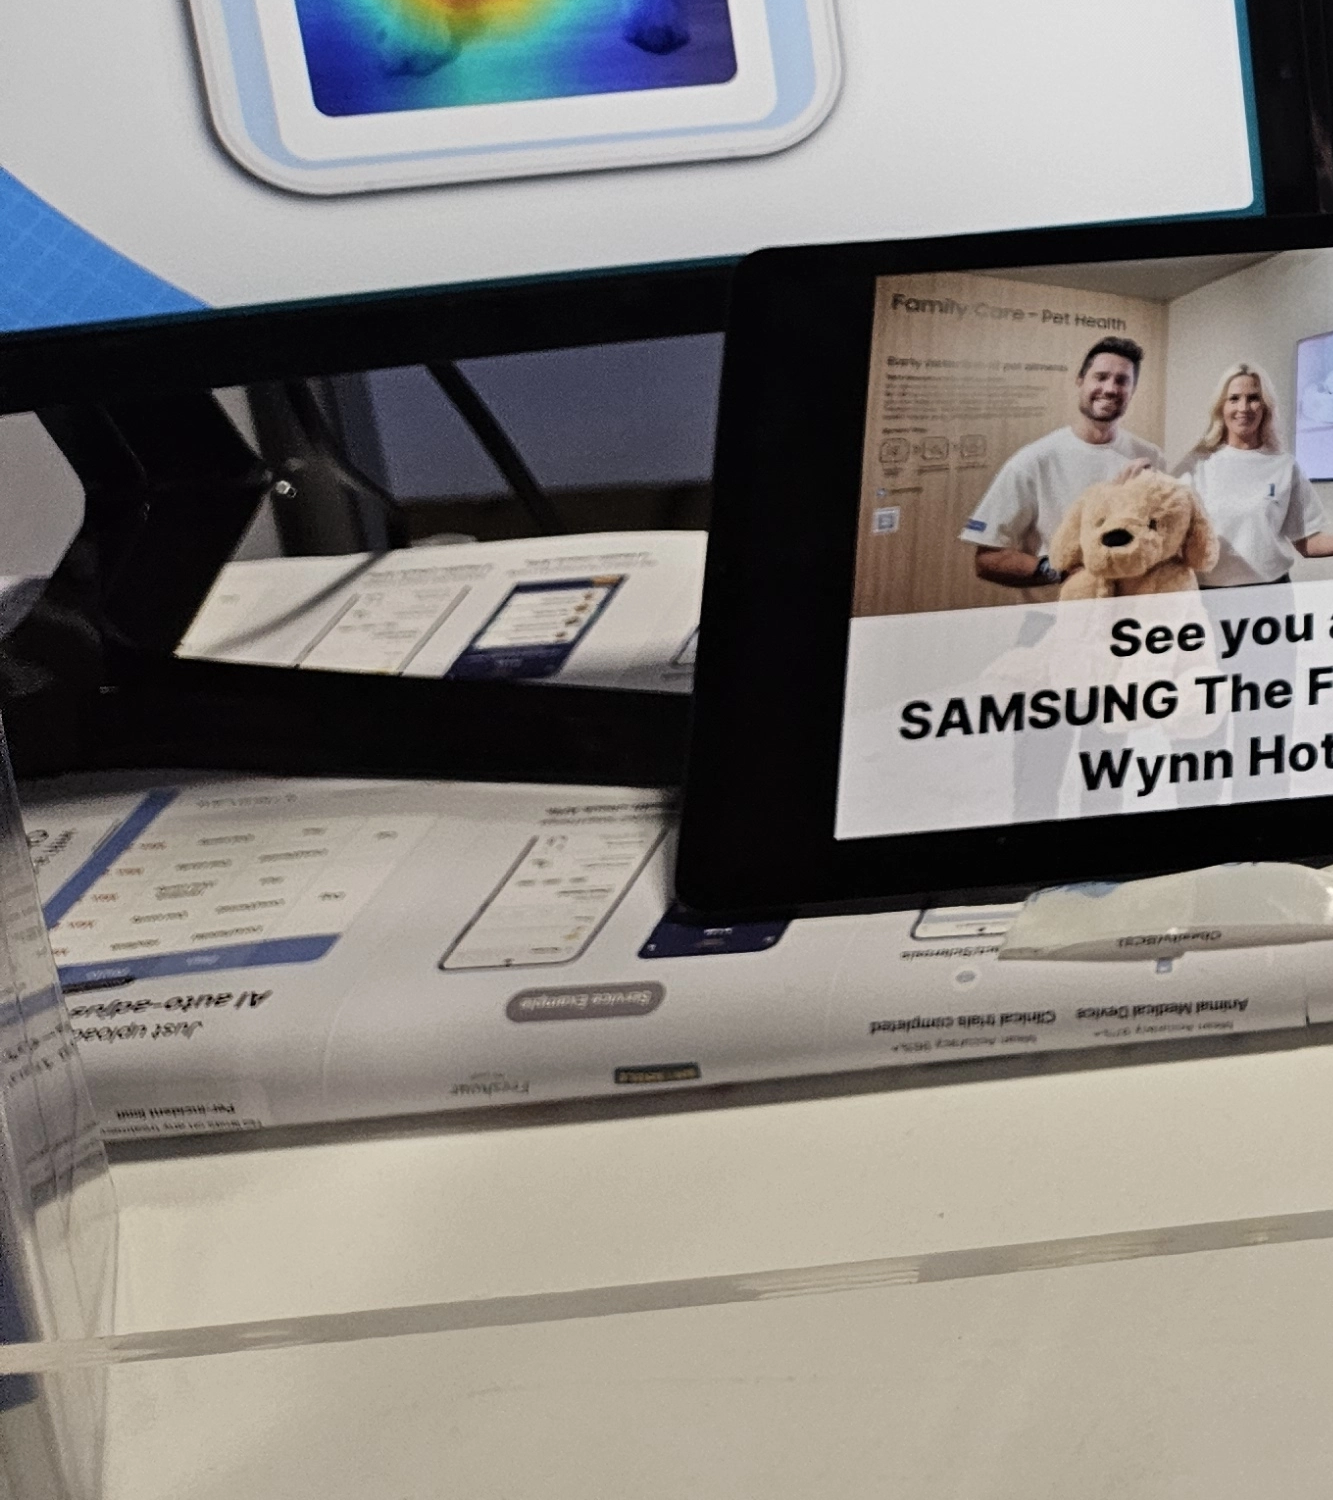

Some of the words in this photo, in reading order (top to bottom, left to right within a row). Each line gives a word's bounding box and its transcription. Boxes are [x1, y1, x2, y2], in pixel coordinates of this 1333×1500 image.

[891, 293, 969, 319] Family
[974, 302, 1025, 321] Care
[1041, 308, 1070, 327] Pet
[1074, 311, 1127, 332] Health
[1109, 617, 1207, 658] See
[1220, 608, 1315, 660] you
[898, 677, 1180, 743] SAMSUNG
[1195, 666, 1294, 717] The
[1079, 744, 1234, 799] Wynn
[999, 1009, 1058, 1028] Clinical
[1133, 1001, 1191, 1019] Medical
[1191, 997, 1250, 1016] Animal
